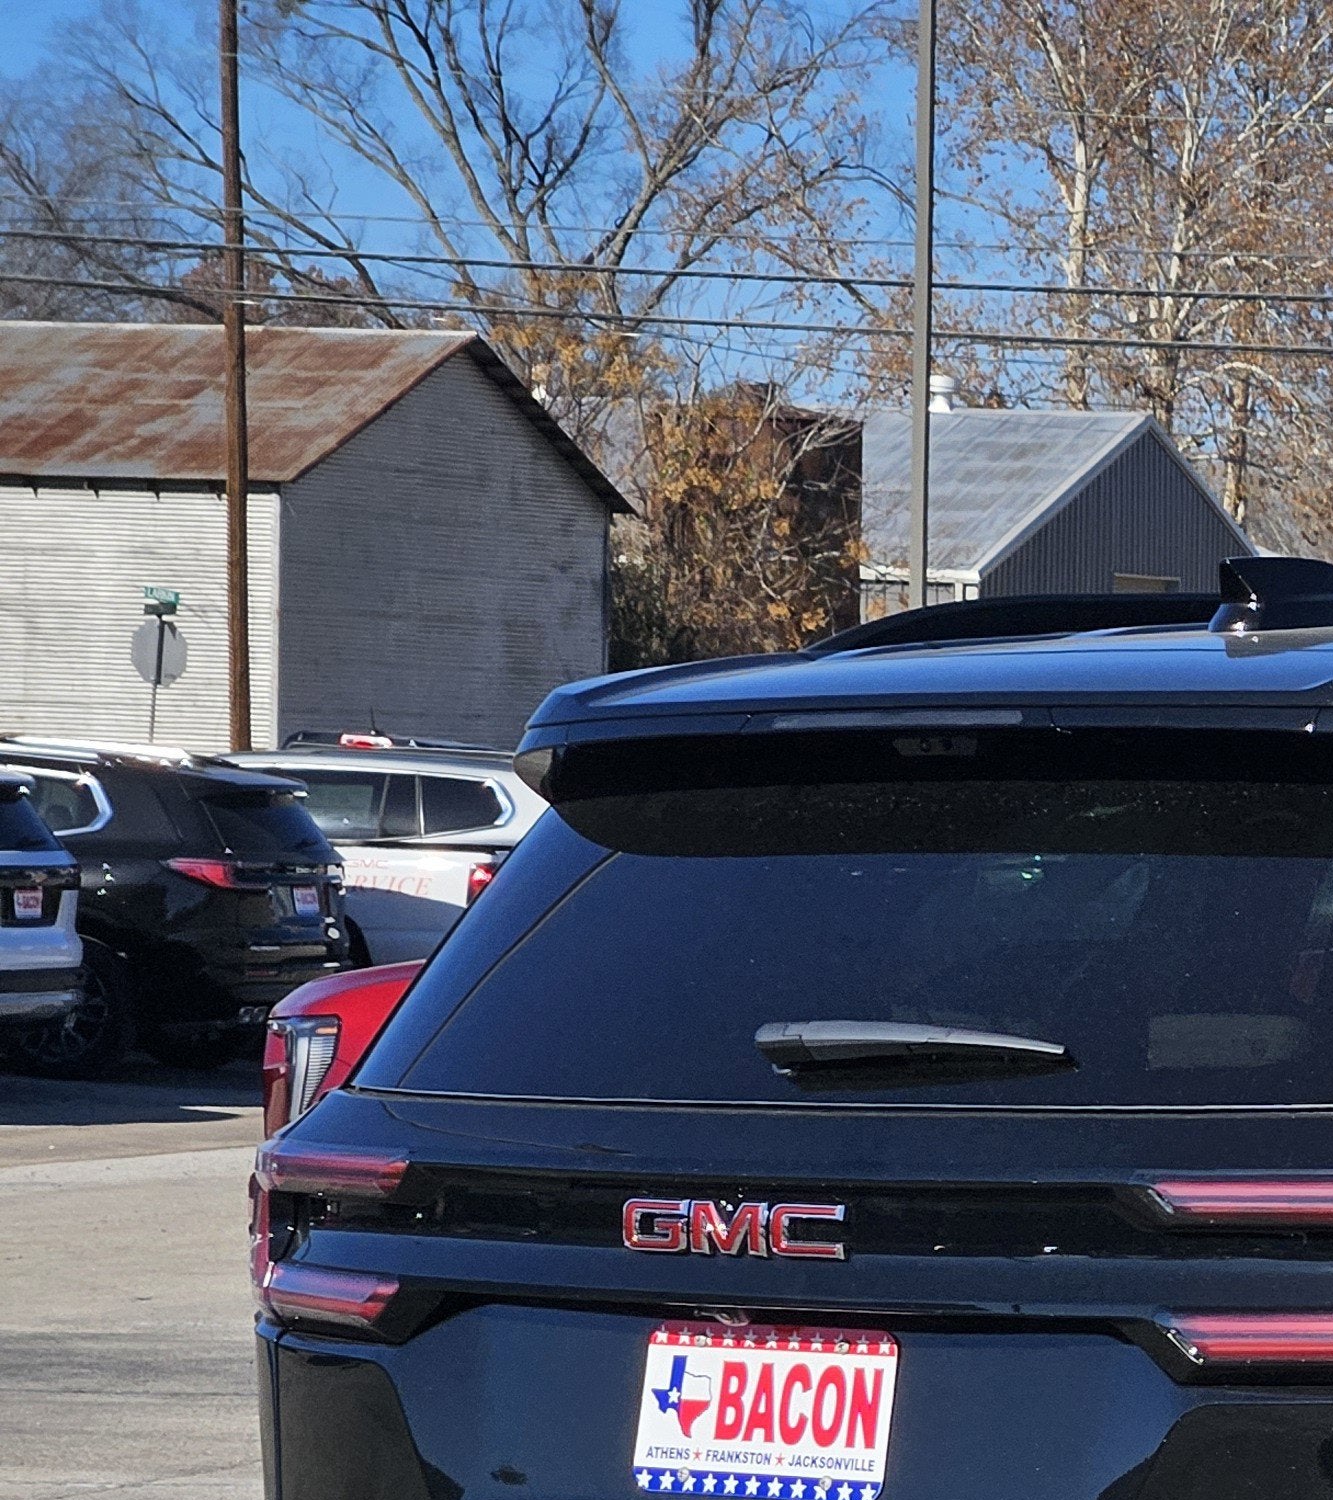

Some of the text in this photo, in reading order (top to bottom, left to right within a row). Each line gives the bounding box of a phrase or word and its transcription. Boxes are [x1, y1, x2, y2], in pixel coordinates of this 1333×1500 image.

[623, 1198, 846, 1260] GMC
[713, 1360, 884, 1449] BACON
[646, 1446, 875, 1472] ATHENS FRANKSTON JACKSONVILLE
